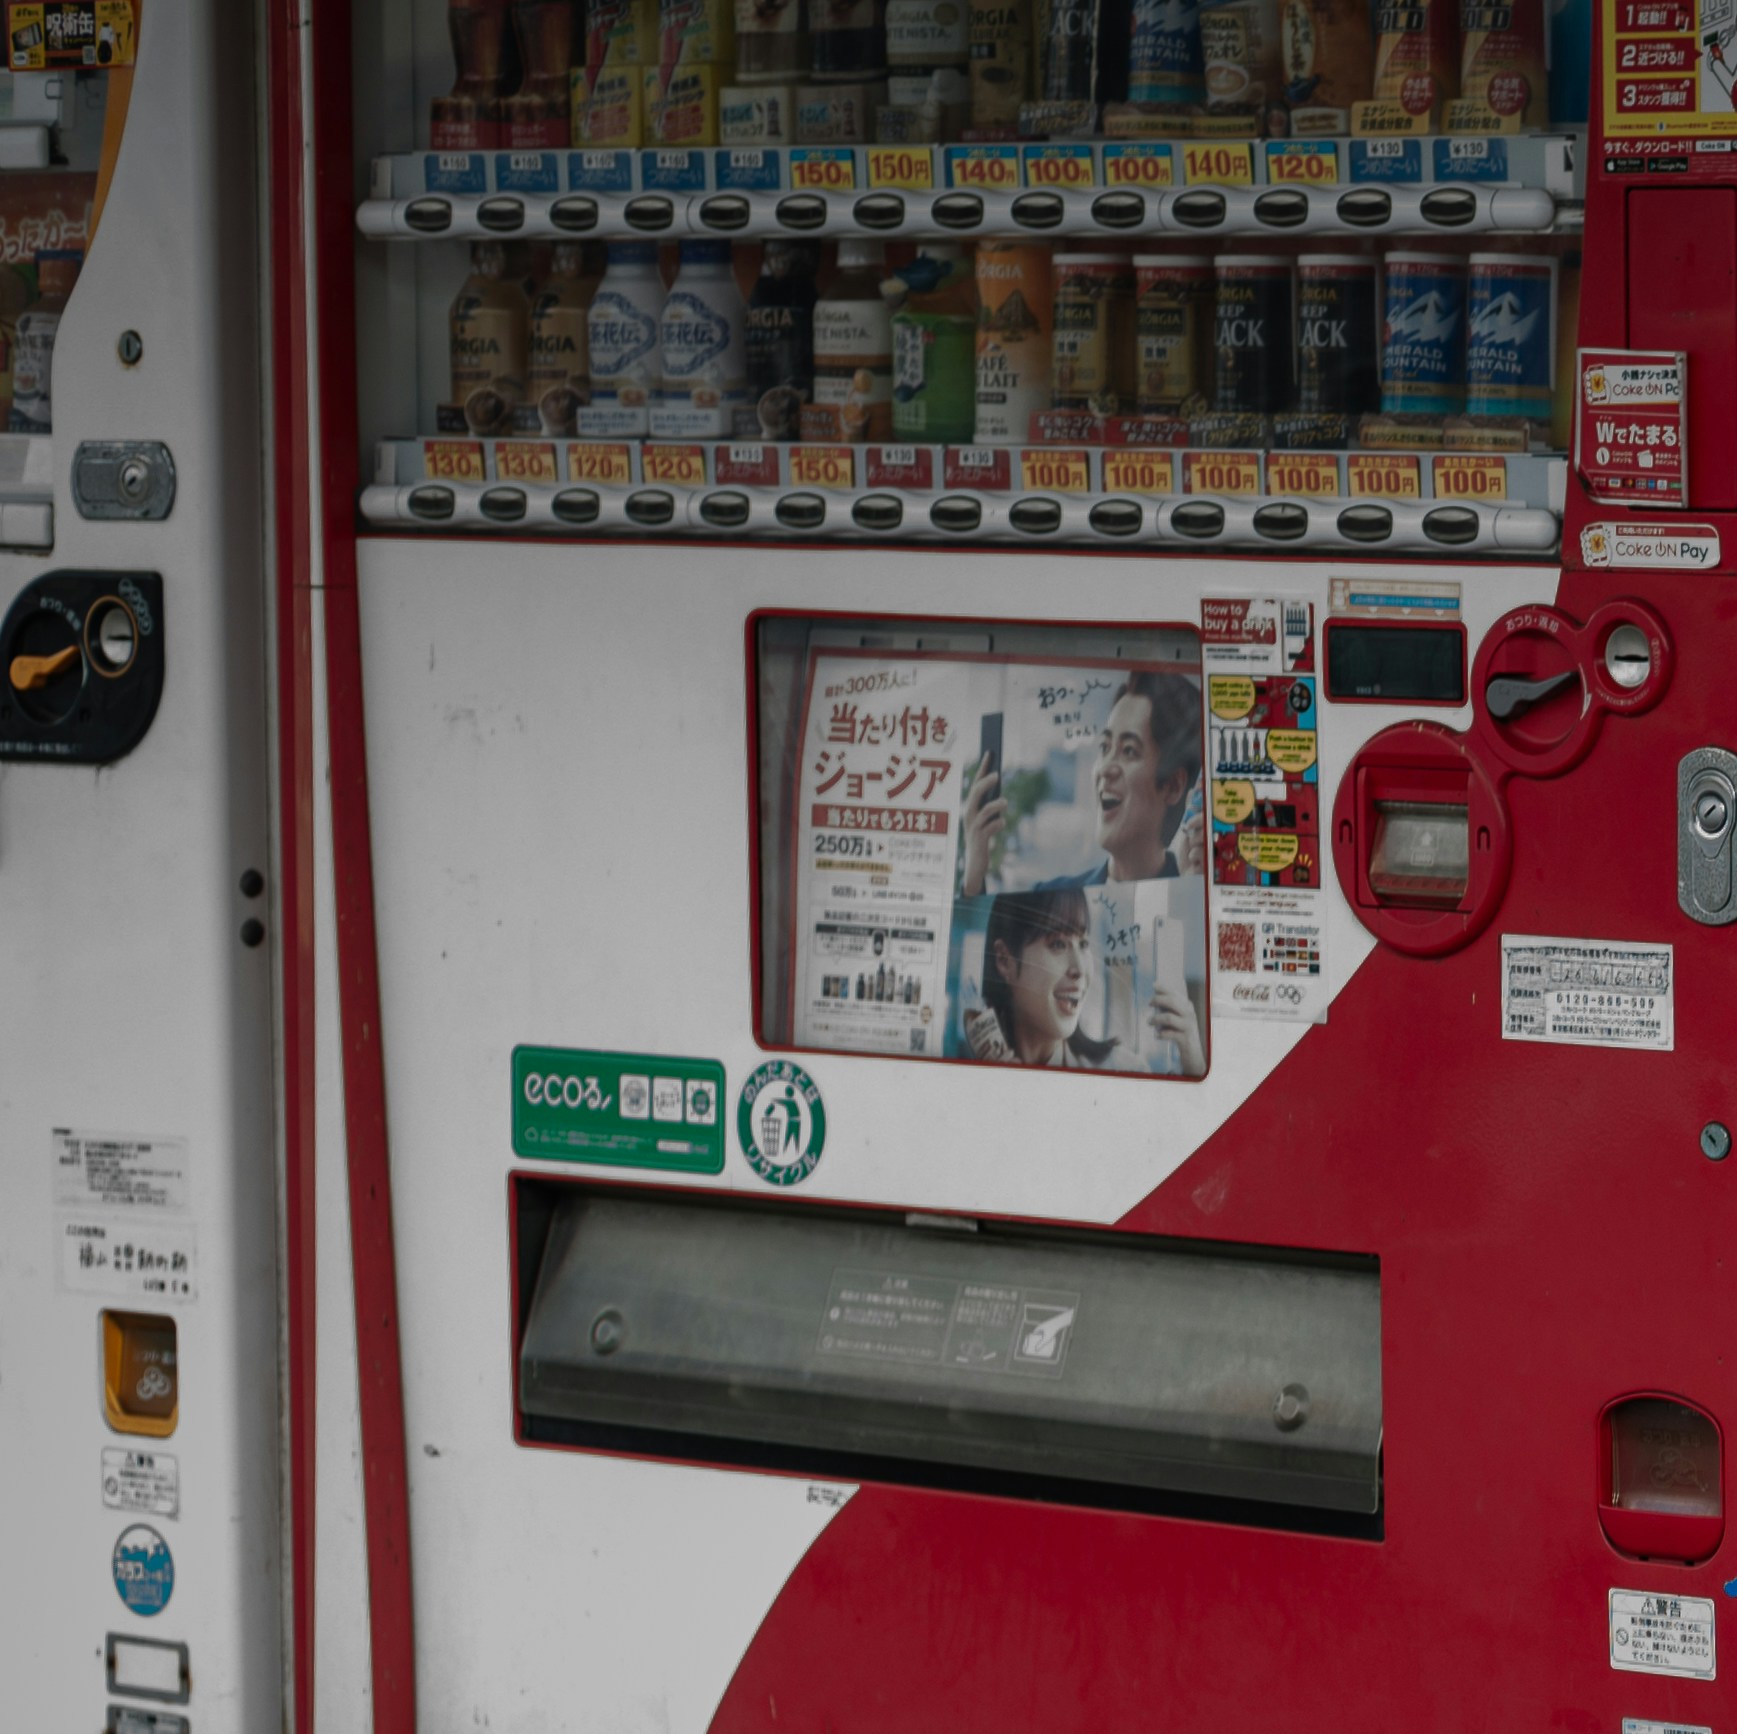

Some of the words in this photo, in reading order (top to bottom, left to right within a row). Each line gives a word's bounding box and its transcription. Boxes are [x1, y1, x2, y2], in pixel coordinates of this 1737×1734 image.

[1626, 4, 1634, 27] 1
[1621, 44, 1637, 68] 2
[1637, 50, 1685, 67] 近づける!!
[1621, 84, 1638, 108] 3
[1370, 142, 1400, 155] ¥130
[1453, 142, 1484, 155] ¥130
[871, 153, 929, 181] 150円
[1184, 148, 1248, 178] 140円
[1612, 382, 1643, 396] Coke
[1645, 382, 1663, 396] ON
[1025, 463, 1085, 490] 100円
[1109, 463, 1169, 490] 100円
[1195, 464, 1255, 491] 100円
[1273, 467, 1334, 493] 100円
[1352, 468, 1415, 494] 100円
[1438, 468, 1501, 494] 100円
[1615, 541, 1652, 557] Coke
[1655, 541, 1677, 557] ON
[1680, 542, 1709, 563] Pay
[1204, 603, 1229, 616] How
[1230, 603, 1243, 616] to
[1204, 617, 1228, 633] buy
[1230, 619, 1240, 631] a
[828, 702, 949, 746] 当たり付き
[814, 751, 951, 801] ジョージア
[1655, 1598, 1682, 1619] 警告
